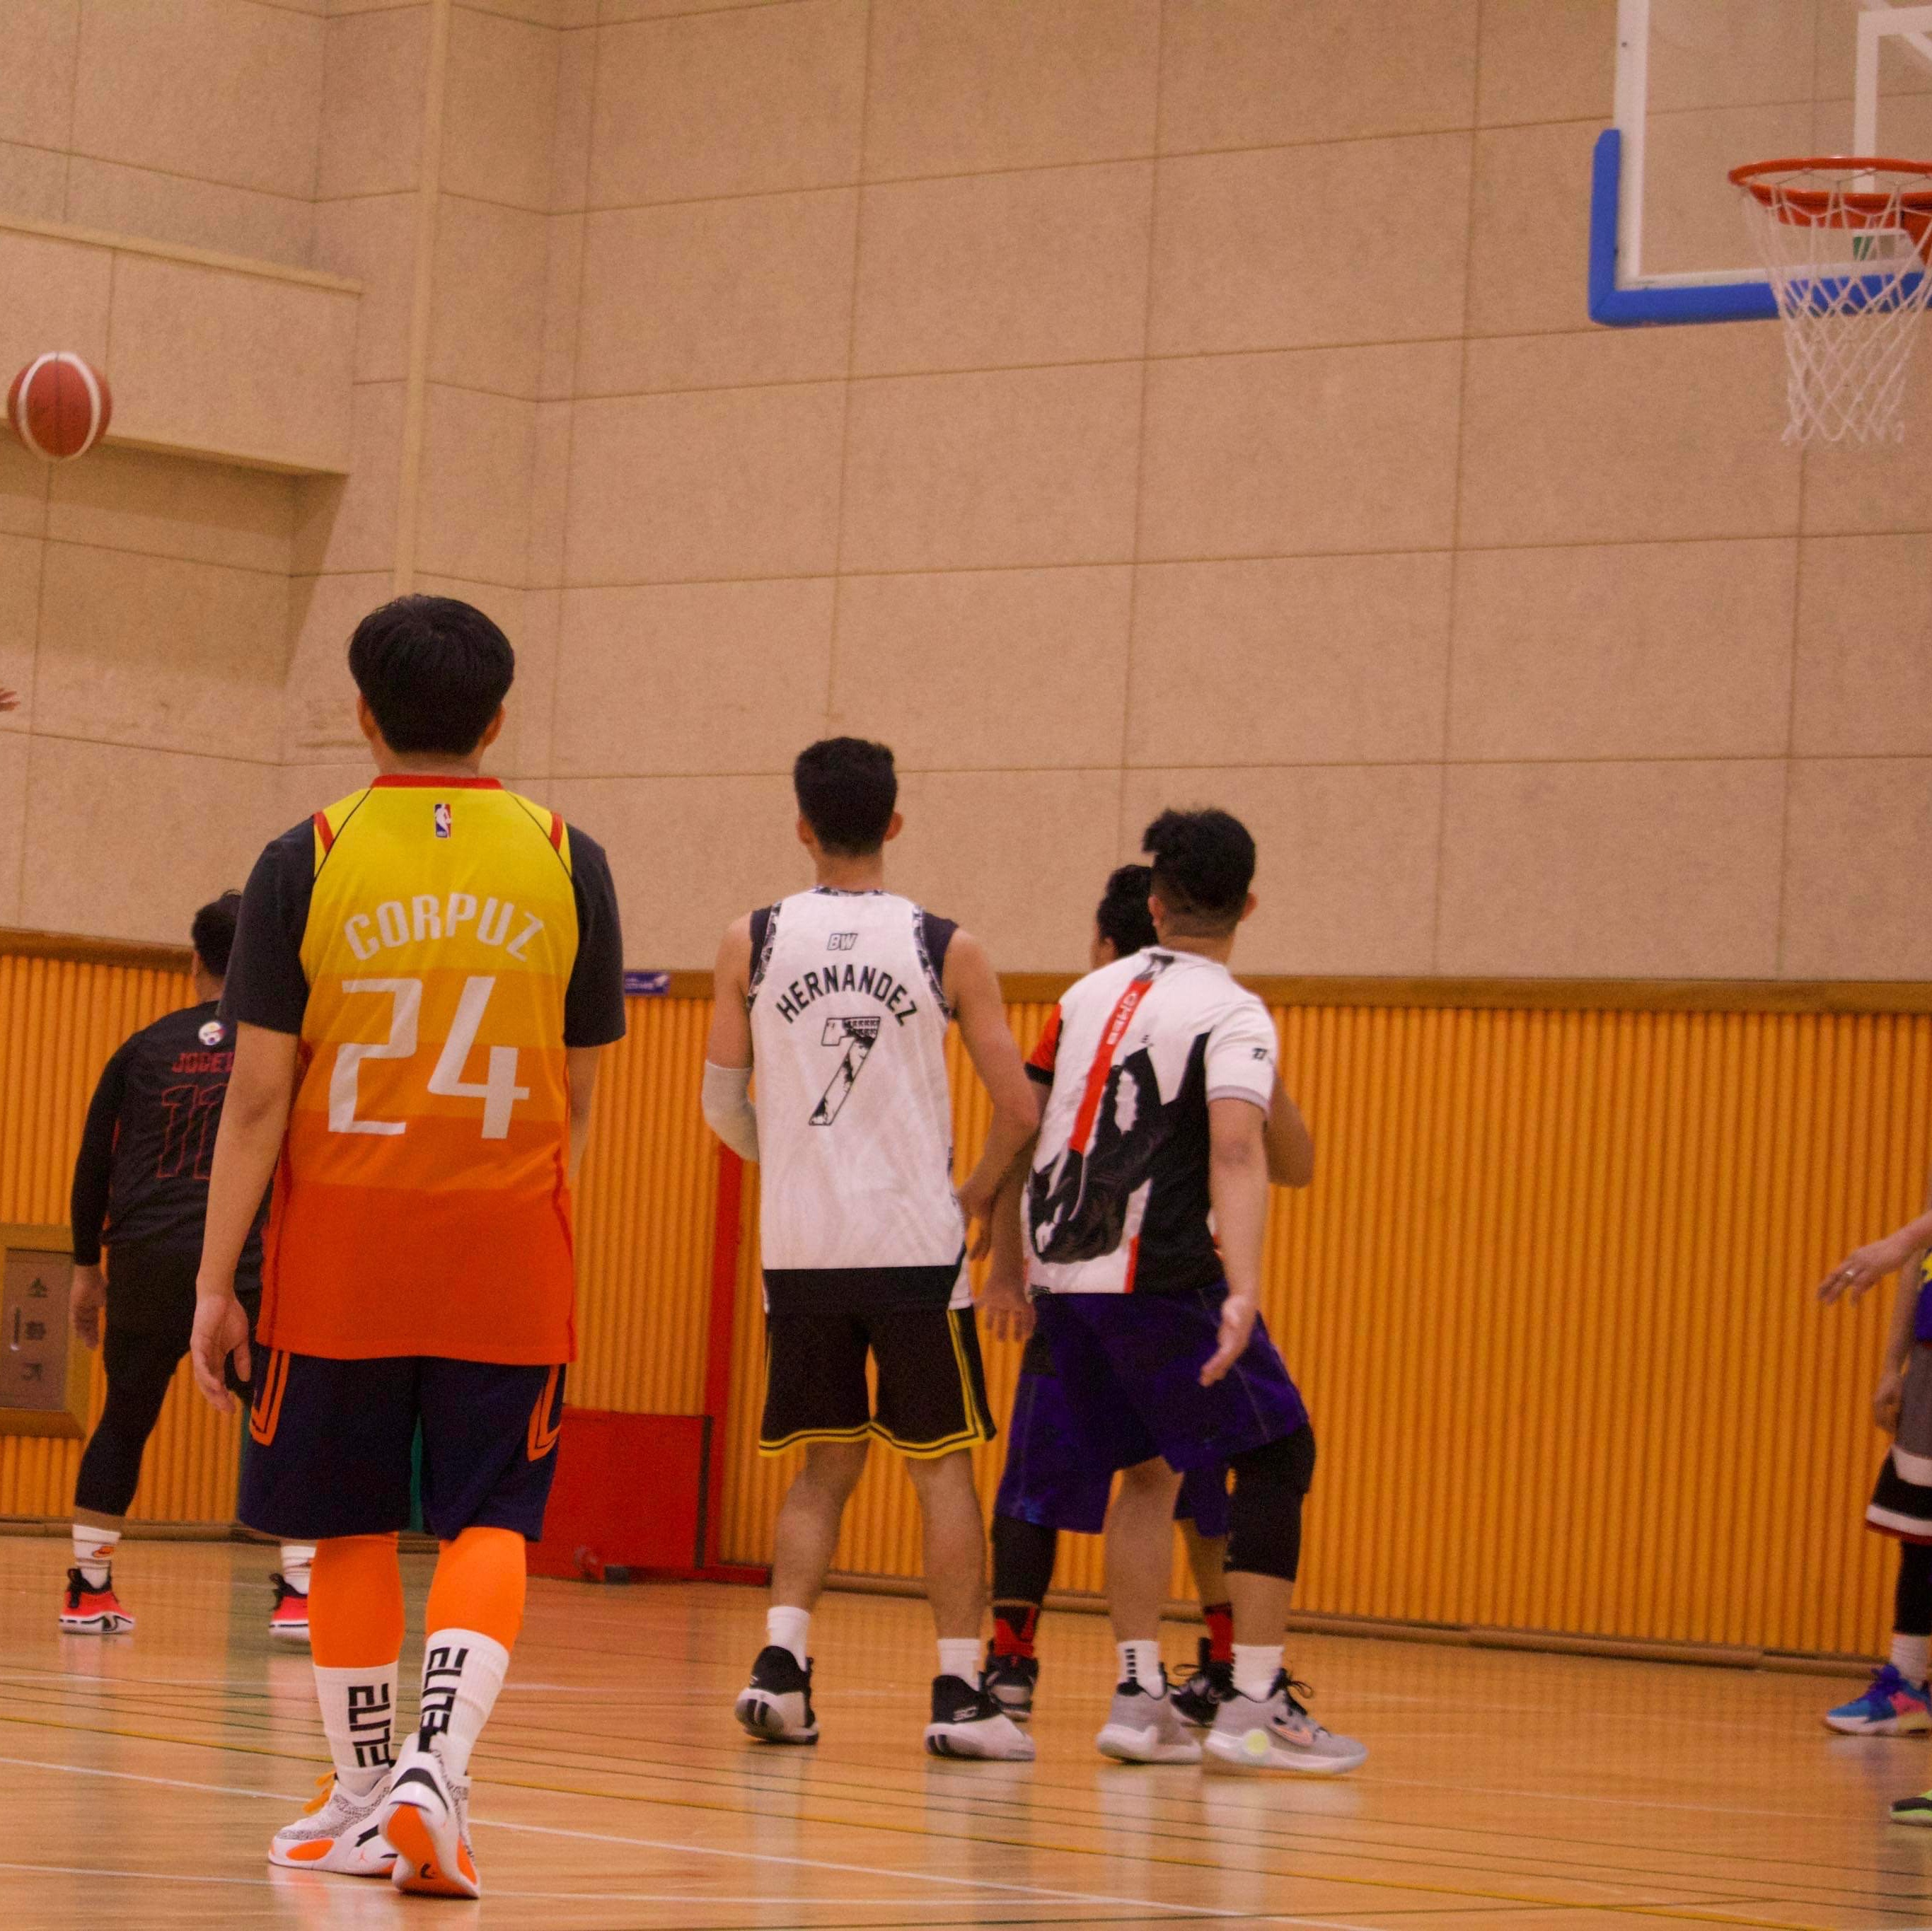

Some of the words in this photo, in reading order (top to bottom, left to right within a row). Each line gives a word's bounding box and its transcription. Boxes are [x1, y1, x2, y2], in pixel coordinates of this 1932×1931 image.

[343, 892, 544, 962] CORPUZ
[826, 933, 858, 951] BW
[775, 964, 918, 1026] HERNANDEZ
[328, 976, 529, 1140] 24
[808, 1016, 881, 1126] 7
